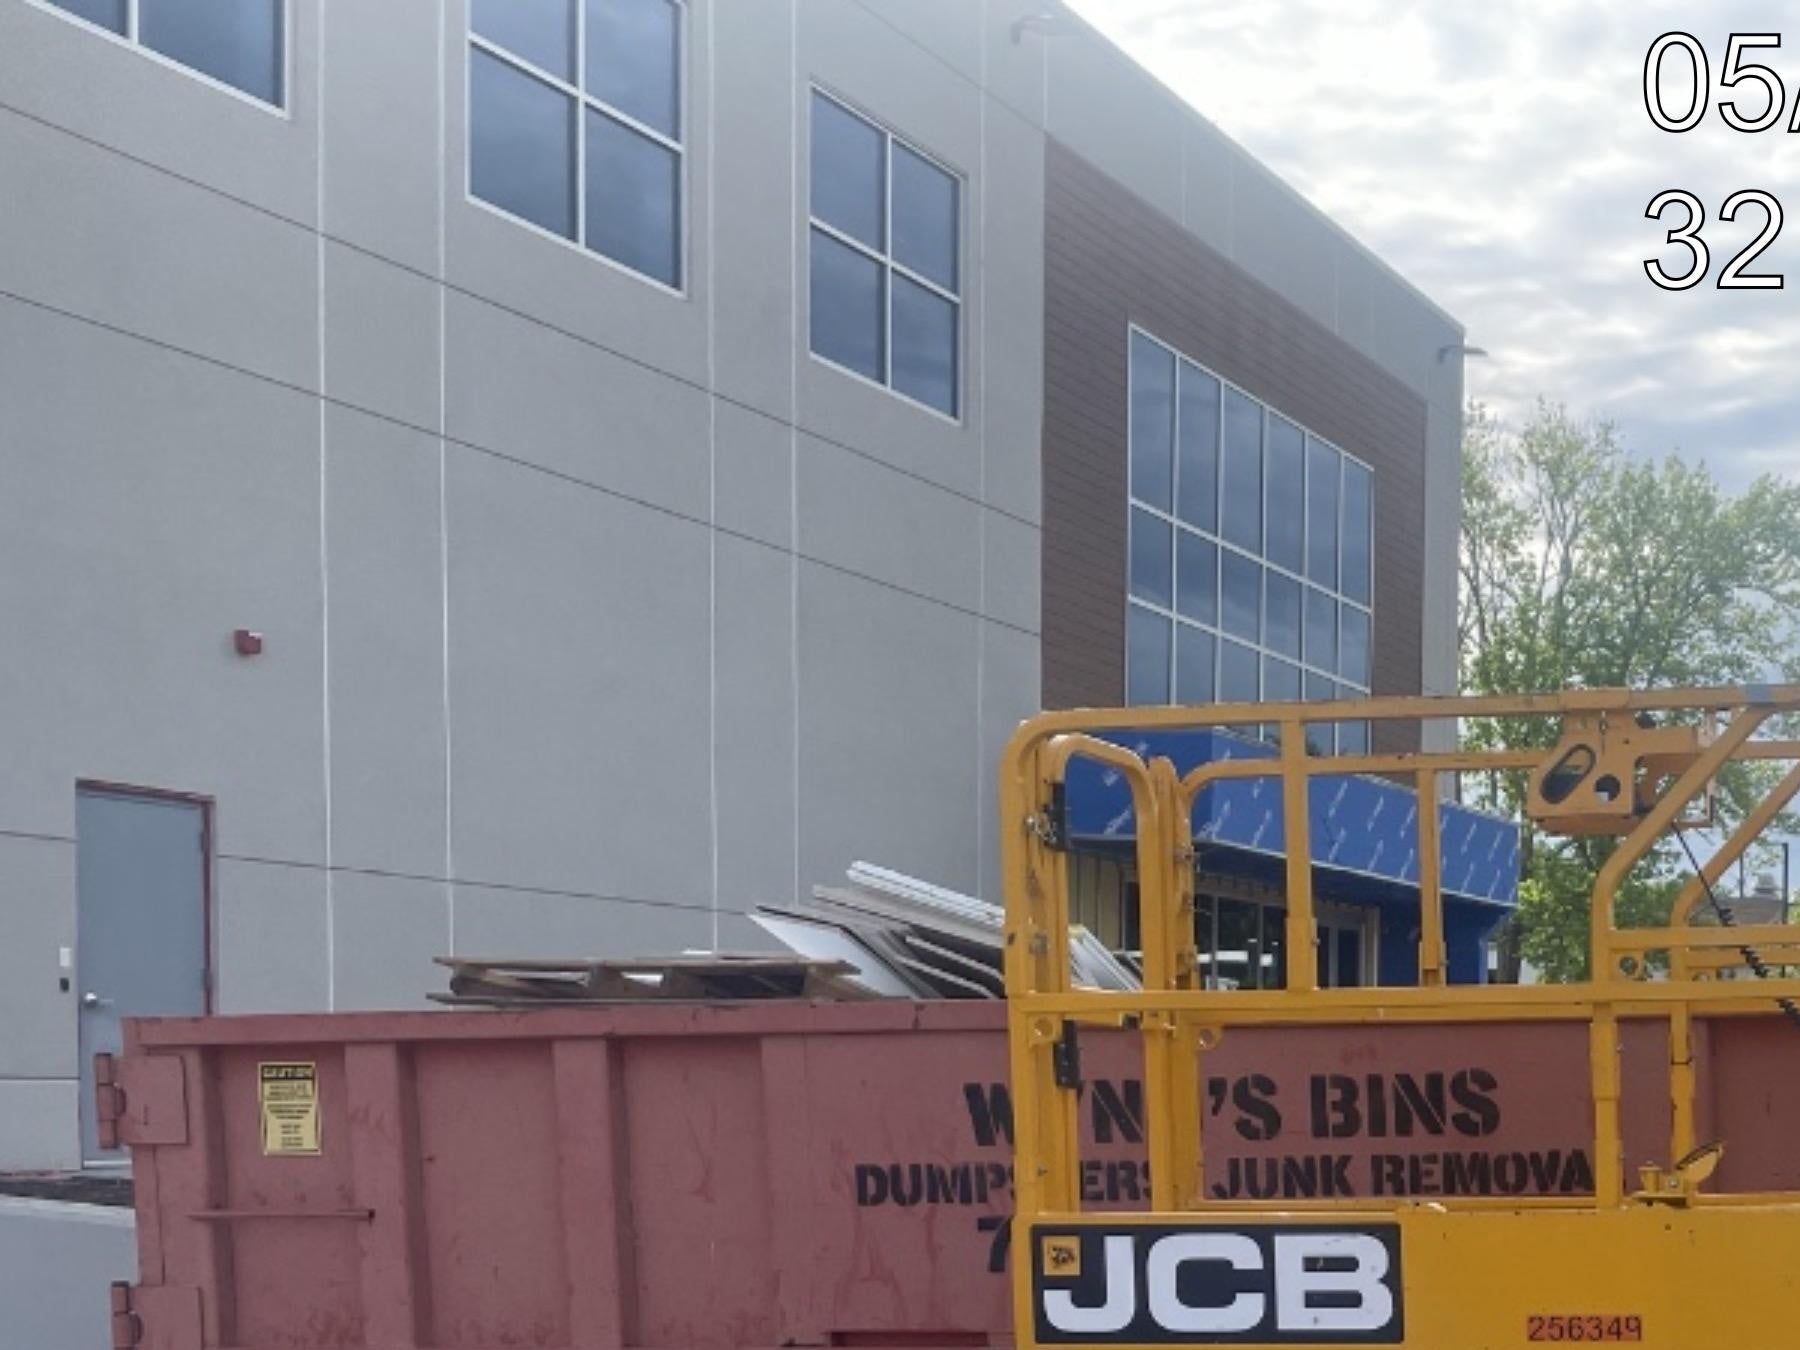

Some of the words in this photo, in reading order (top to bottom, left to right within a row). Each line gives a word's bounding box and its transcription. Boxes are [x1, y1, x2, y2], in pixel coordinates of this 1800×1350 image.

[1310, 1069, 1501, 1138] BINS
[1211, 1153, 1353, 1199] JUNK
[1371, 1149, 1598, 1196] REMOVA
[1043, 1233, 1393, 1333] JCB
[1528, 1315, 1642, 1342] 256349
